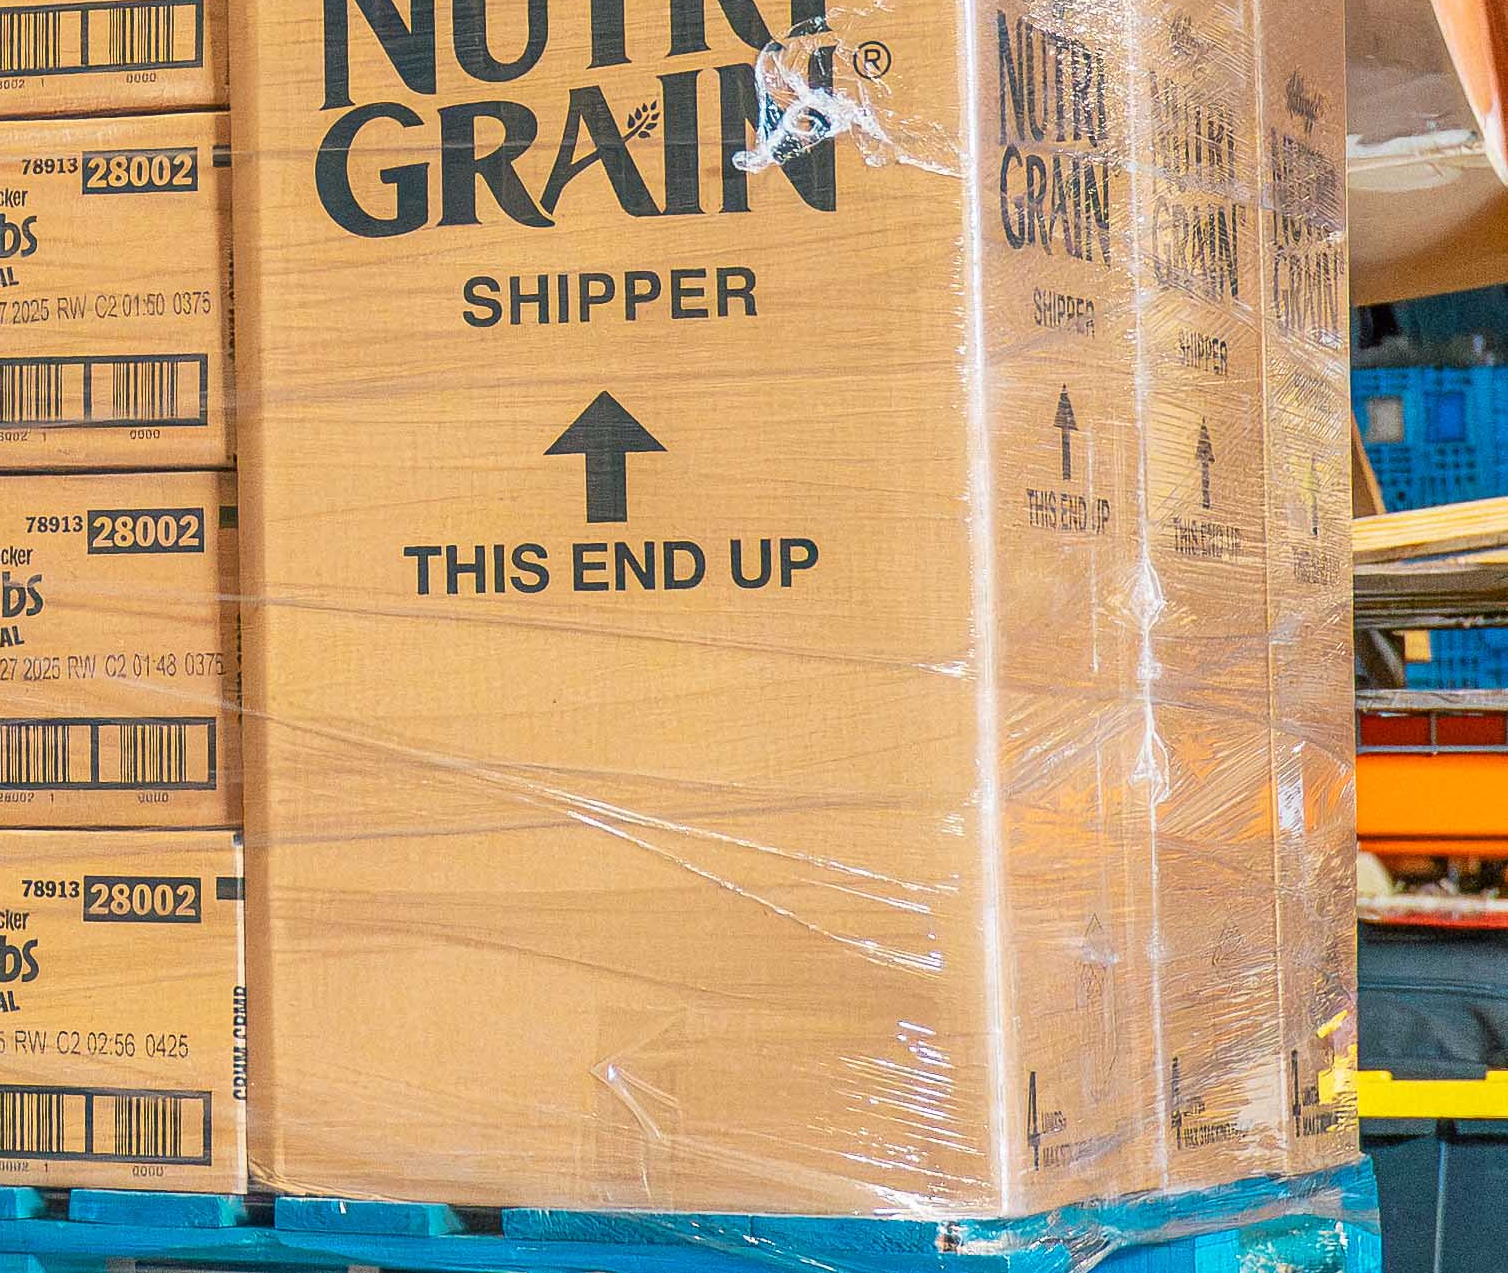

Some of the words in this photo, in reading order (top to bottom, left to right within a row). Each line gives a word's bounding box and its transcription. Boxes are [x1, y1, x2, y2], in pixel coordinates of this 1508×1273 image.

[314, 45, 838, 239] GRAIN
[21, 158, 78, 176] 78913
[86, 153, 195, 188] 28002
[998, 143, 1112, 266] GRAIN
[462, 267, 758, 328] SHIPPER
[1033, 287, 1096, 338] SHIPPER
[25, 515, 83, 534] 78913
[92, 514, 201, 548] 28002
[1026, 488, 1057, 531] THIS
[403, 543, 550, 595] THIS
[573, 540, 706, 592] END
[730, 538, 820, 589] UP
[21, 880, 80, 899] 78913
[88, 881, 198, 917] 28002
[13, 1031, 49, 1055] RW
[56, 1031, 81, 1056] C2
[87, 1032, 136, 1057] 02:56
[145, 1033, 190, 1058] 0425
